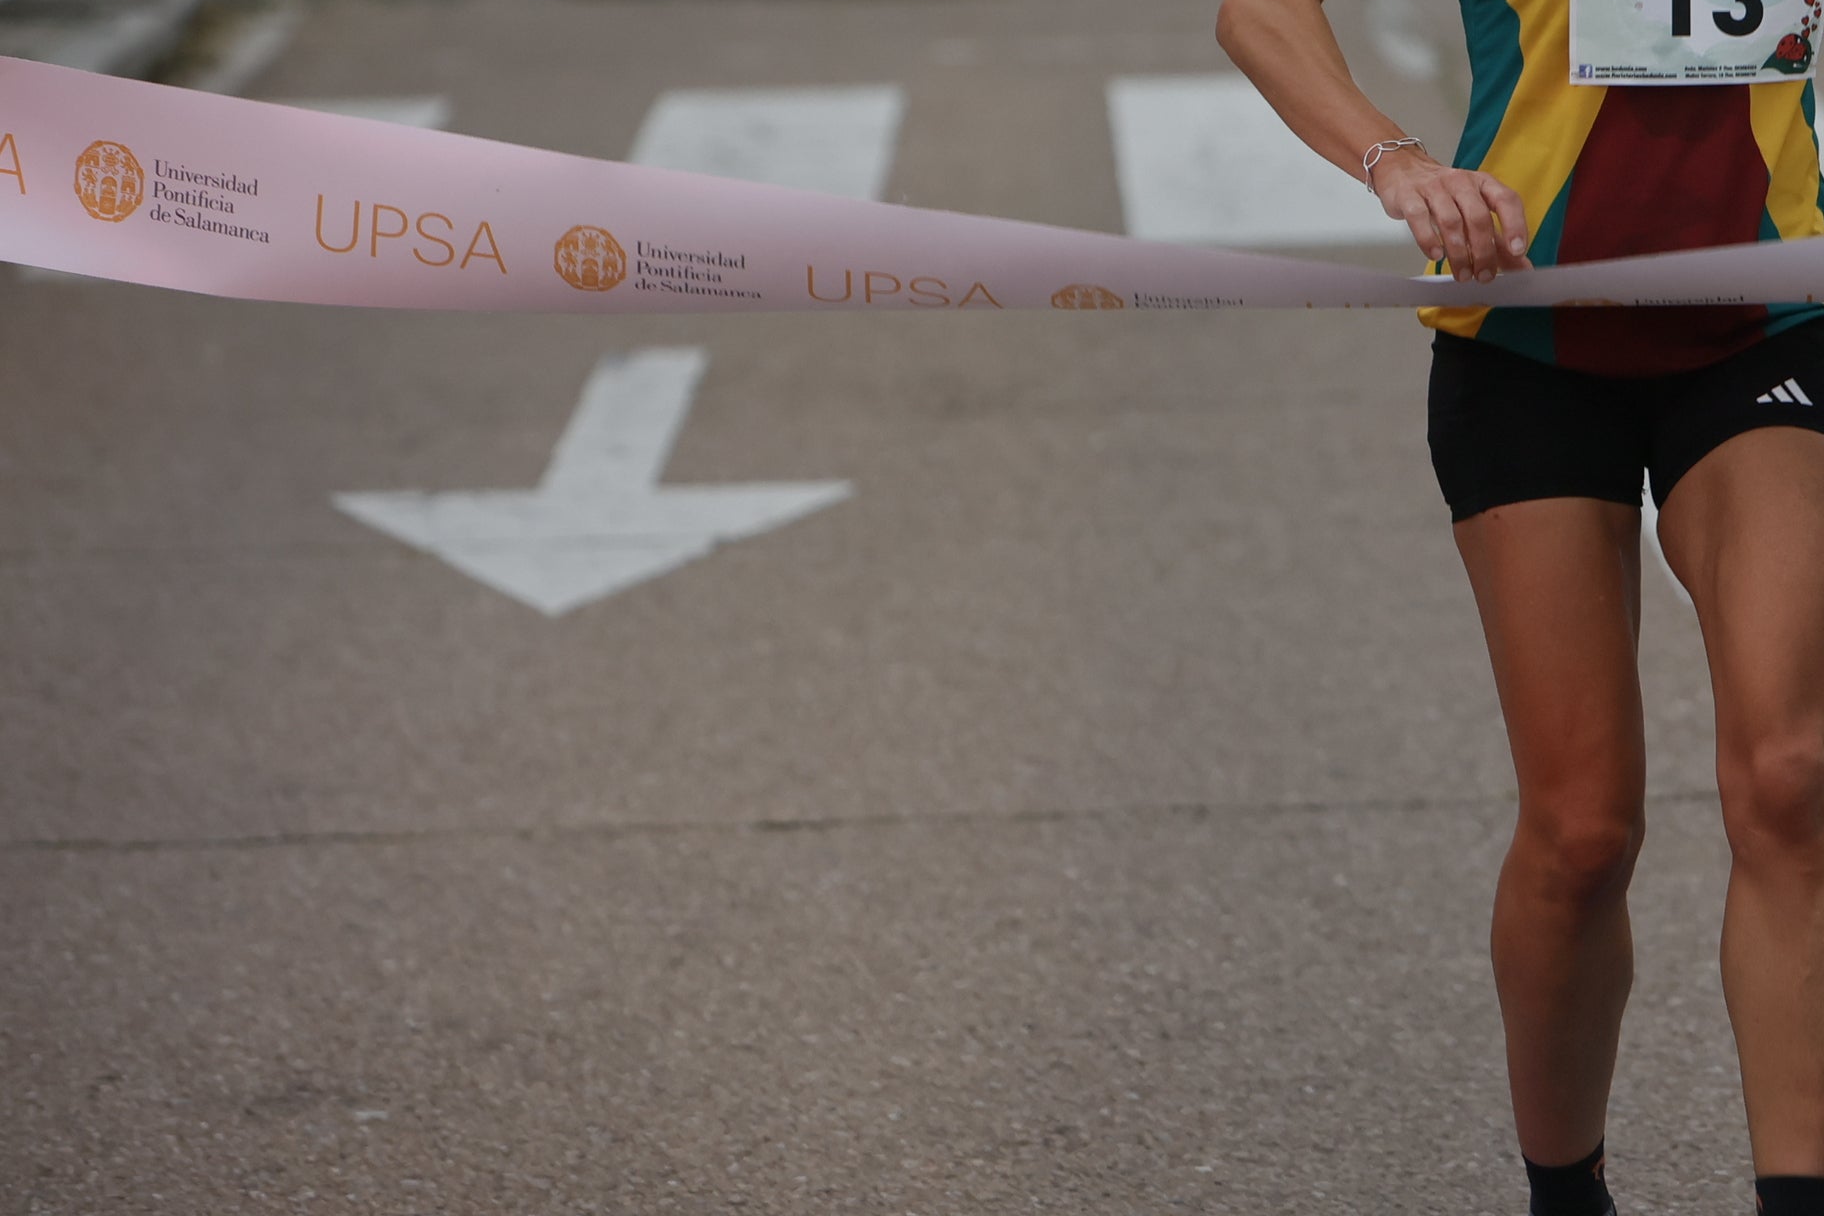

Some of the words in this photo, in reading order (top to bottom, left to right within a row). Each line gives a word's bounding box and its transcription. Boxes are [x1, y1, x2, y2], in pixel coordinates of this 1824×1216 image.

[154, 158, 259, 196] Universidad
[153, 180, 235, 214] Pontificia
[149, 203, 172, 223] de
[174, 207, 270, 244] Salamanca
[314, 193, 507, 275] UPSA
[636, 241, 745, 270] Universidad
[636, 261, 723, 284] Pontificia
[806, 264, 1004, 310] UPSA
